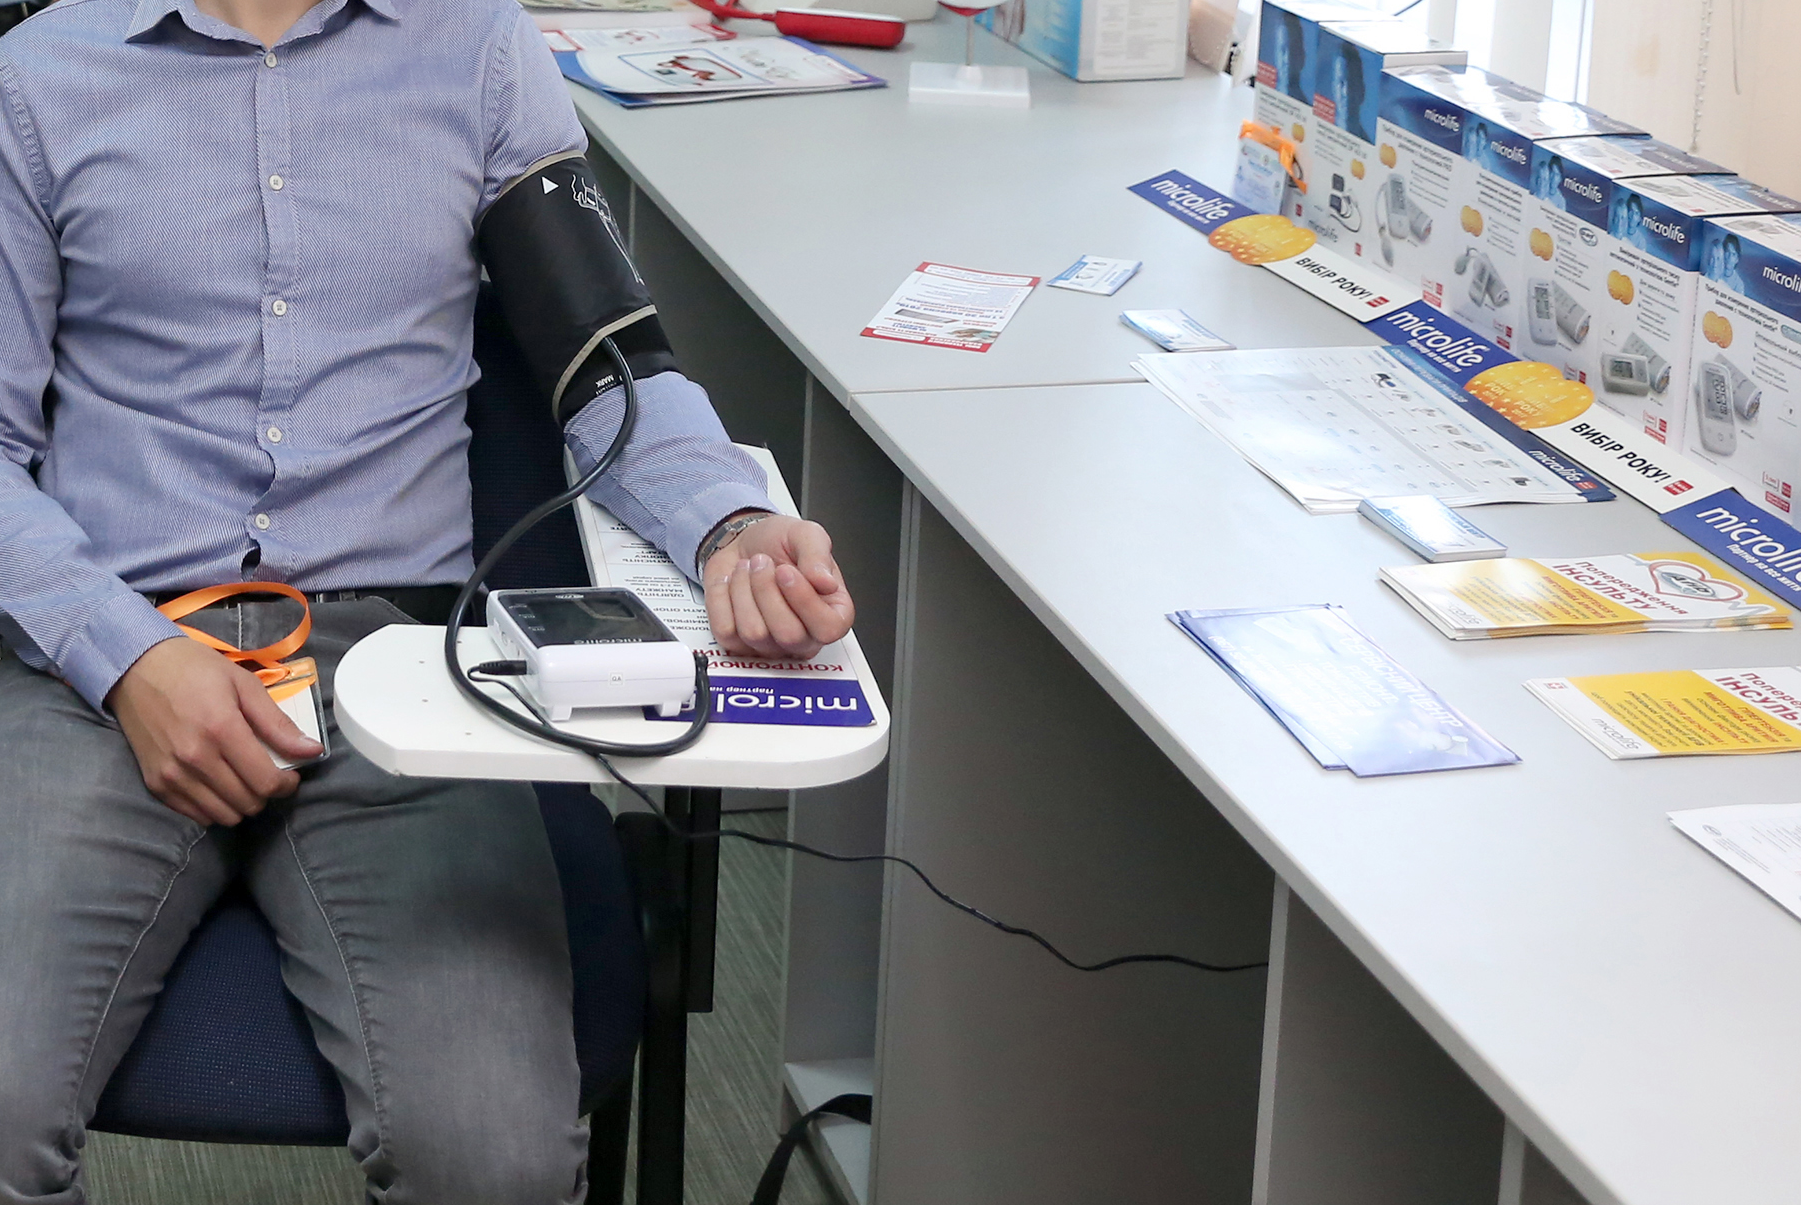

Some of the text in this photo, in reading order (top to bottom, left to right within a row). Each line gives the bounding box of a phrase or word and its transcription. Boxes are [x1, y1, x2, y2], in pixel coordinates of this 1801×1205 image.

[1424, 107, 1460, 133] microlife
[1490, 140, 1527, 165] microlife
[1151, 179, 1236, 221] microlife
[1563, 177, 1603, 203] microlife
[1642, 215, 1686, 244] microlife
[1296, 256, 1374, 300] ВИБІР РОКУ!
[1762, 266, 1801, 294] microli
[1386, 310, 1490, 367] microlife
[1528, 449, 1584, 484] microlife
[1570, 421, 1672, 489] ВИБІР РОКУ!
[1696, 507, 1801, 584] microli
[1726, 544, 1759, 565] Партнер
[1755, 559, 1769, 571] на
[1764, 567, 1781, 579] все
[1552, 564, 1658, 610] ІНСУЛЬТУ
[1576, 561, 1689, 615] Попередження
[726, 685, 774, 694] Партнер
[1339, 637, 1464, 728] СЕРВІСНИЙ ЦЕНТР
[1740, 672, 1801, 708] Попере
[717, 693, 857, 714] microl
[1715, 677, 1801, 726] ІНСУЛЬ
[1591, 718, 1642, 750] microlife
